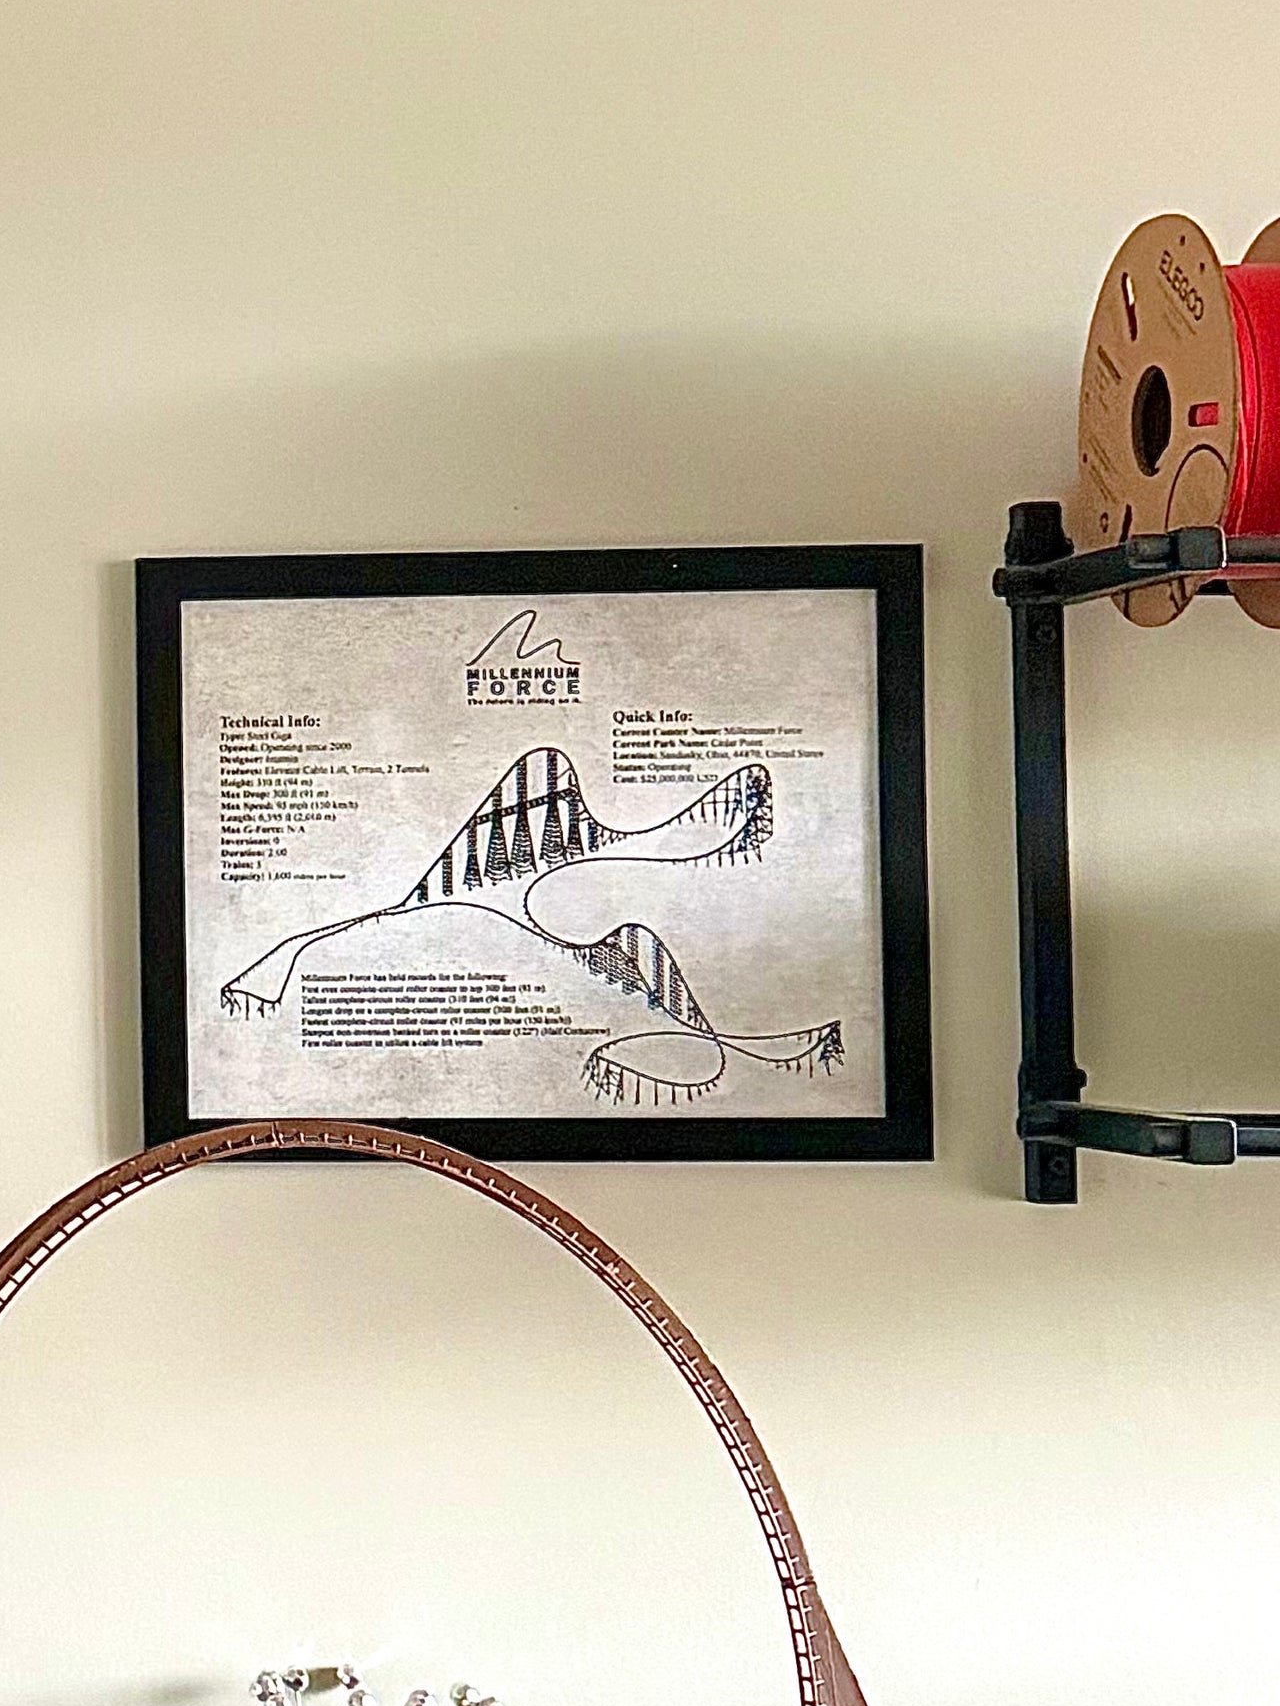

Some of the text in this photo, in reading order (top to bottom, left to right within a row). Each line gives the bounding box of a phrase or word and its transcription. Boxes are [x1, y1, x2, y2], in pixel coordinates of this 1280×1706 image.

[466, 667, 579, 680] MILLENNIUM
[467, 679, 580, 696] FORCE
[220, 715, 321, 729] Technical Info:
[612, 710, 693, 724] Quick Info:
